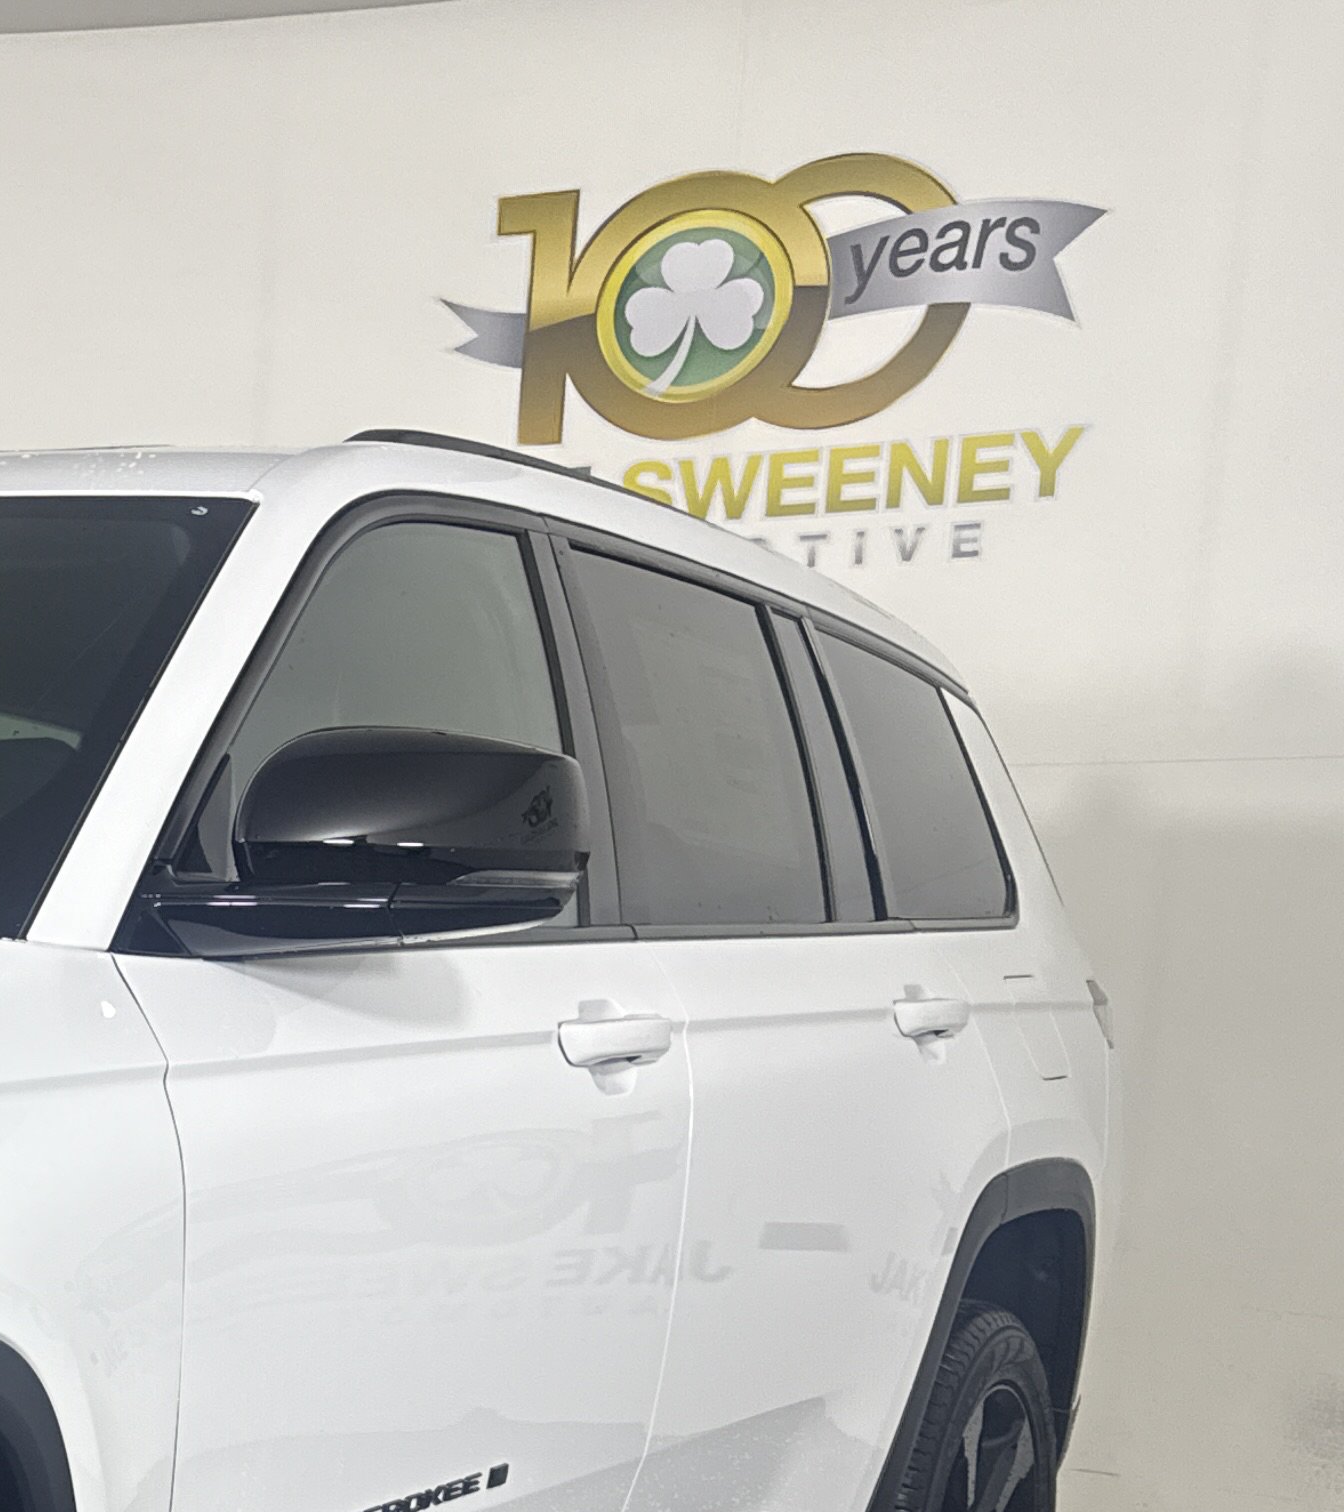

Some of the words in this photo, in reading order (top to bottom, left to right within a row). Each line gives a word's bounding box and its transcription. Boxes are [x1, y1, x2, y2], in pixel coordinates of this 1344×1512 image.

[497, 152, 971, 445] 100
[843, 214, 1040, 305] years
[623, 426, 1085, 520] SWEENEY
[748, 522, 981, 568] TIVE
